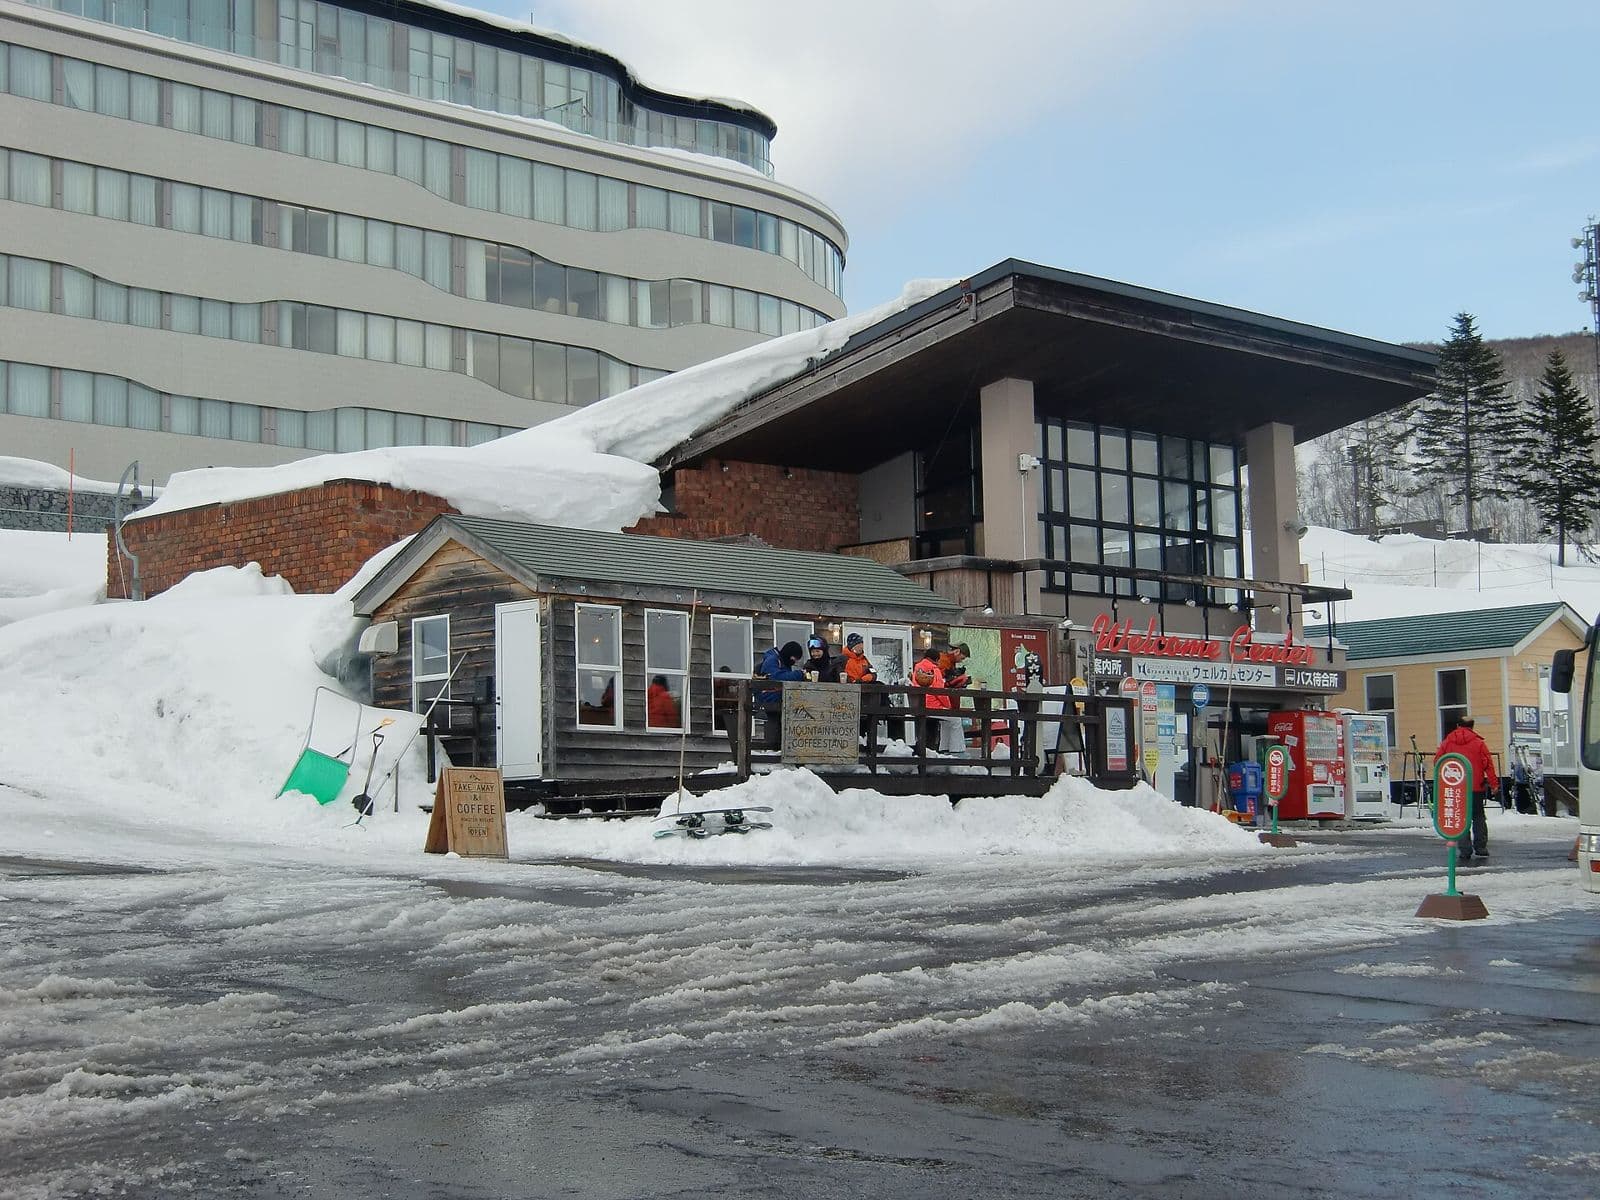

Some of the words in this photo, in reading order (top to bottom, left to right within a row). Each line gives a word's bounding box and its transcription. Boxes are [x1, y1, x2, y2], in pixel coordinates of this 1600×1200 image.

[1092, 613, 1221, 660] Welcome
[1230, 624, 1316, 666] Center
[1192, 666, 1271, 682] ウェルカムセンター
[1296, 671, 1338, 688] バス待合所
[1515, 706, 1537, 723] NGS
[788, 725, 831, 736] MOUNTAIN
[791, 738, 822, 748] COFFEE
[822, 738, 849, 749] STAND
[453, 783, 473, 791] TAKE
[476, 783, 495, 792] AWAY
[457, 803, 497, 815] COFFEE
